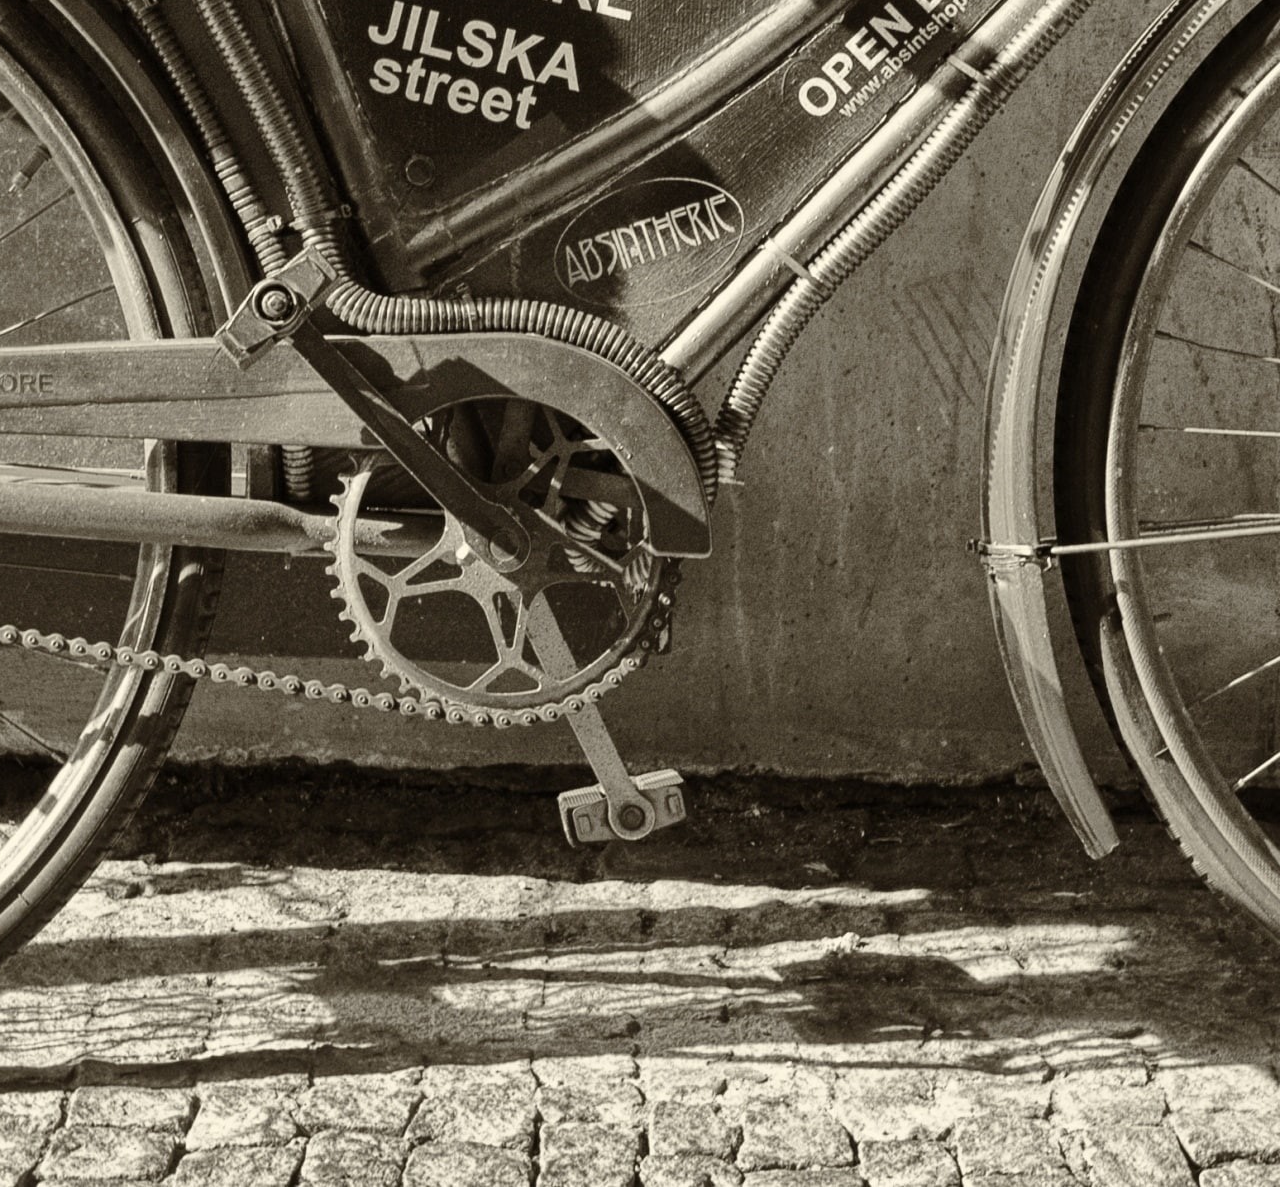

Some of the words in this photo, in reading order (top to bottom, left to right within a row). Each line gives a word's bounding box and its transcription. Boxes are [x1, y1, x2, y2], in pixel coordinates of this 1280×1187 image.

[368, 0, 580, 93] JILSKA
[369, 57, 537, 130] street
[798, 2, 914, 117] OPEN
[565, 193, 735, 288] ABSINTHERIE
